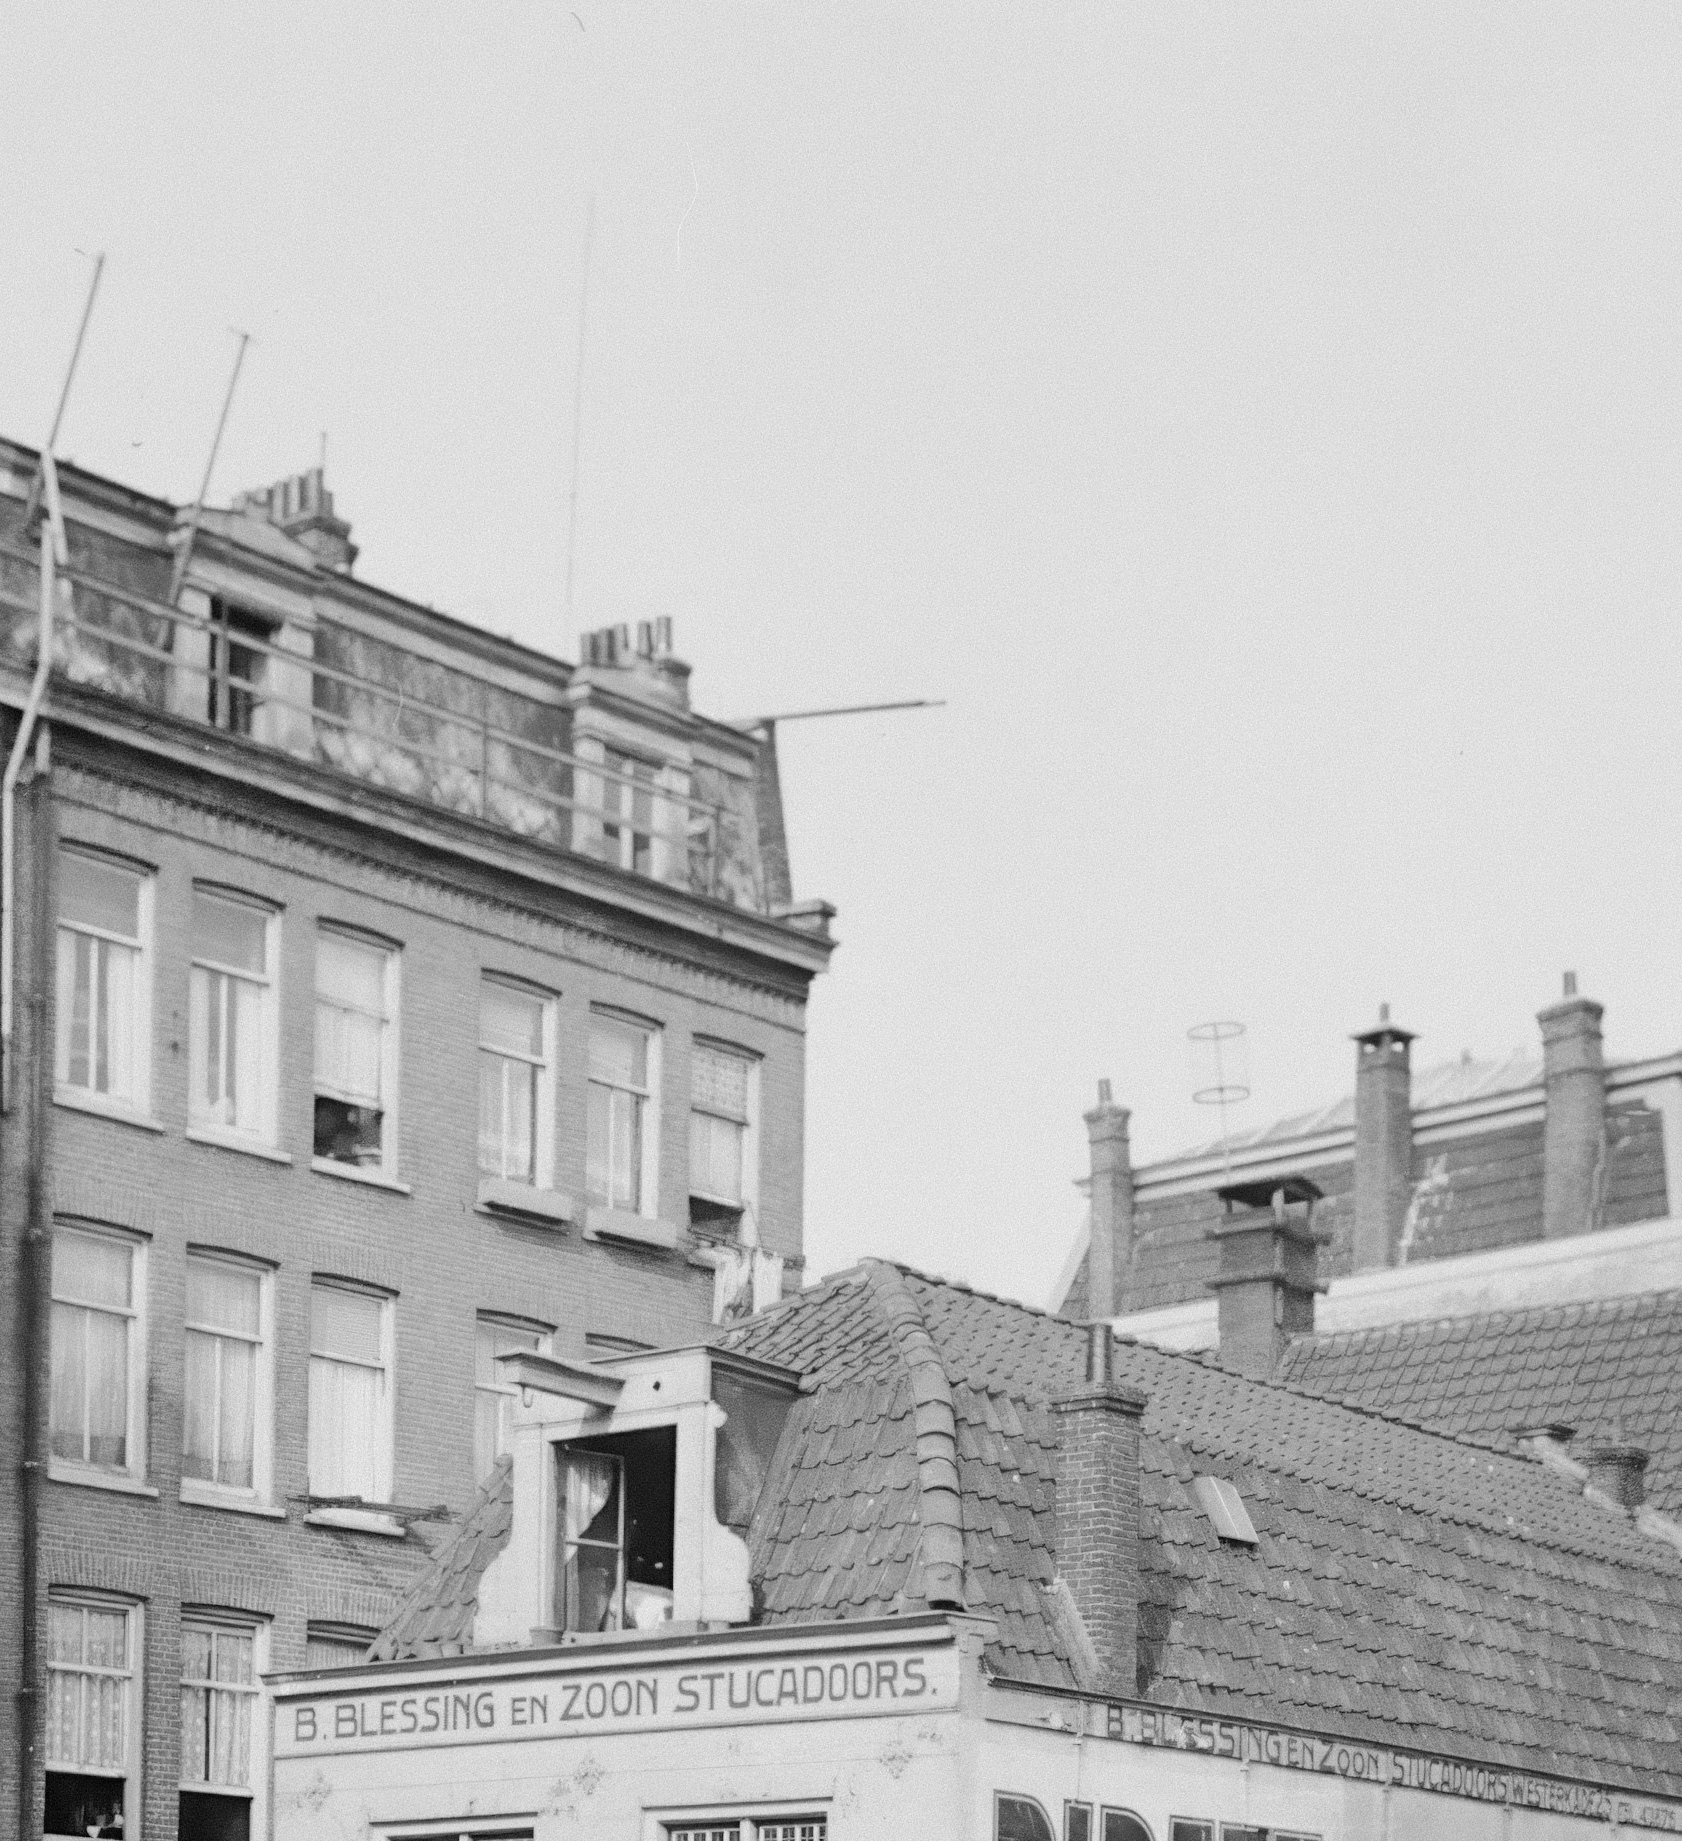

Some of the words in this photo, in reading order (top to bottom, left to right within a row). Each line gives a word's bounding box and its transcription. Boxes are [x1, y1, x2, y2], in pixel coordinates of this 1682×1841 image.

[334, 1692, 495, 1740] BLESSING
[511, 1696, 549, 1728] EN
[559, 1677, 660, 1723] ZOON
[1286, 1737, 1316, 1771] EN
[1318, 1737, 1380, 1782] ZOON
[1392, 1754, 1507, 1802] STUCADOORS
